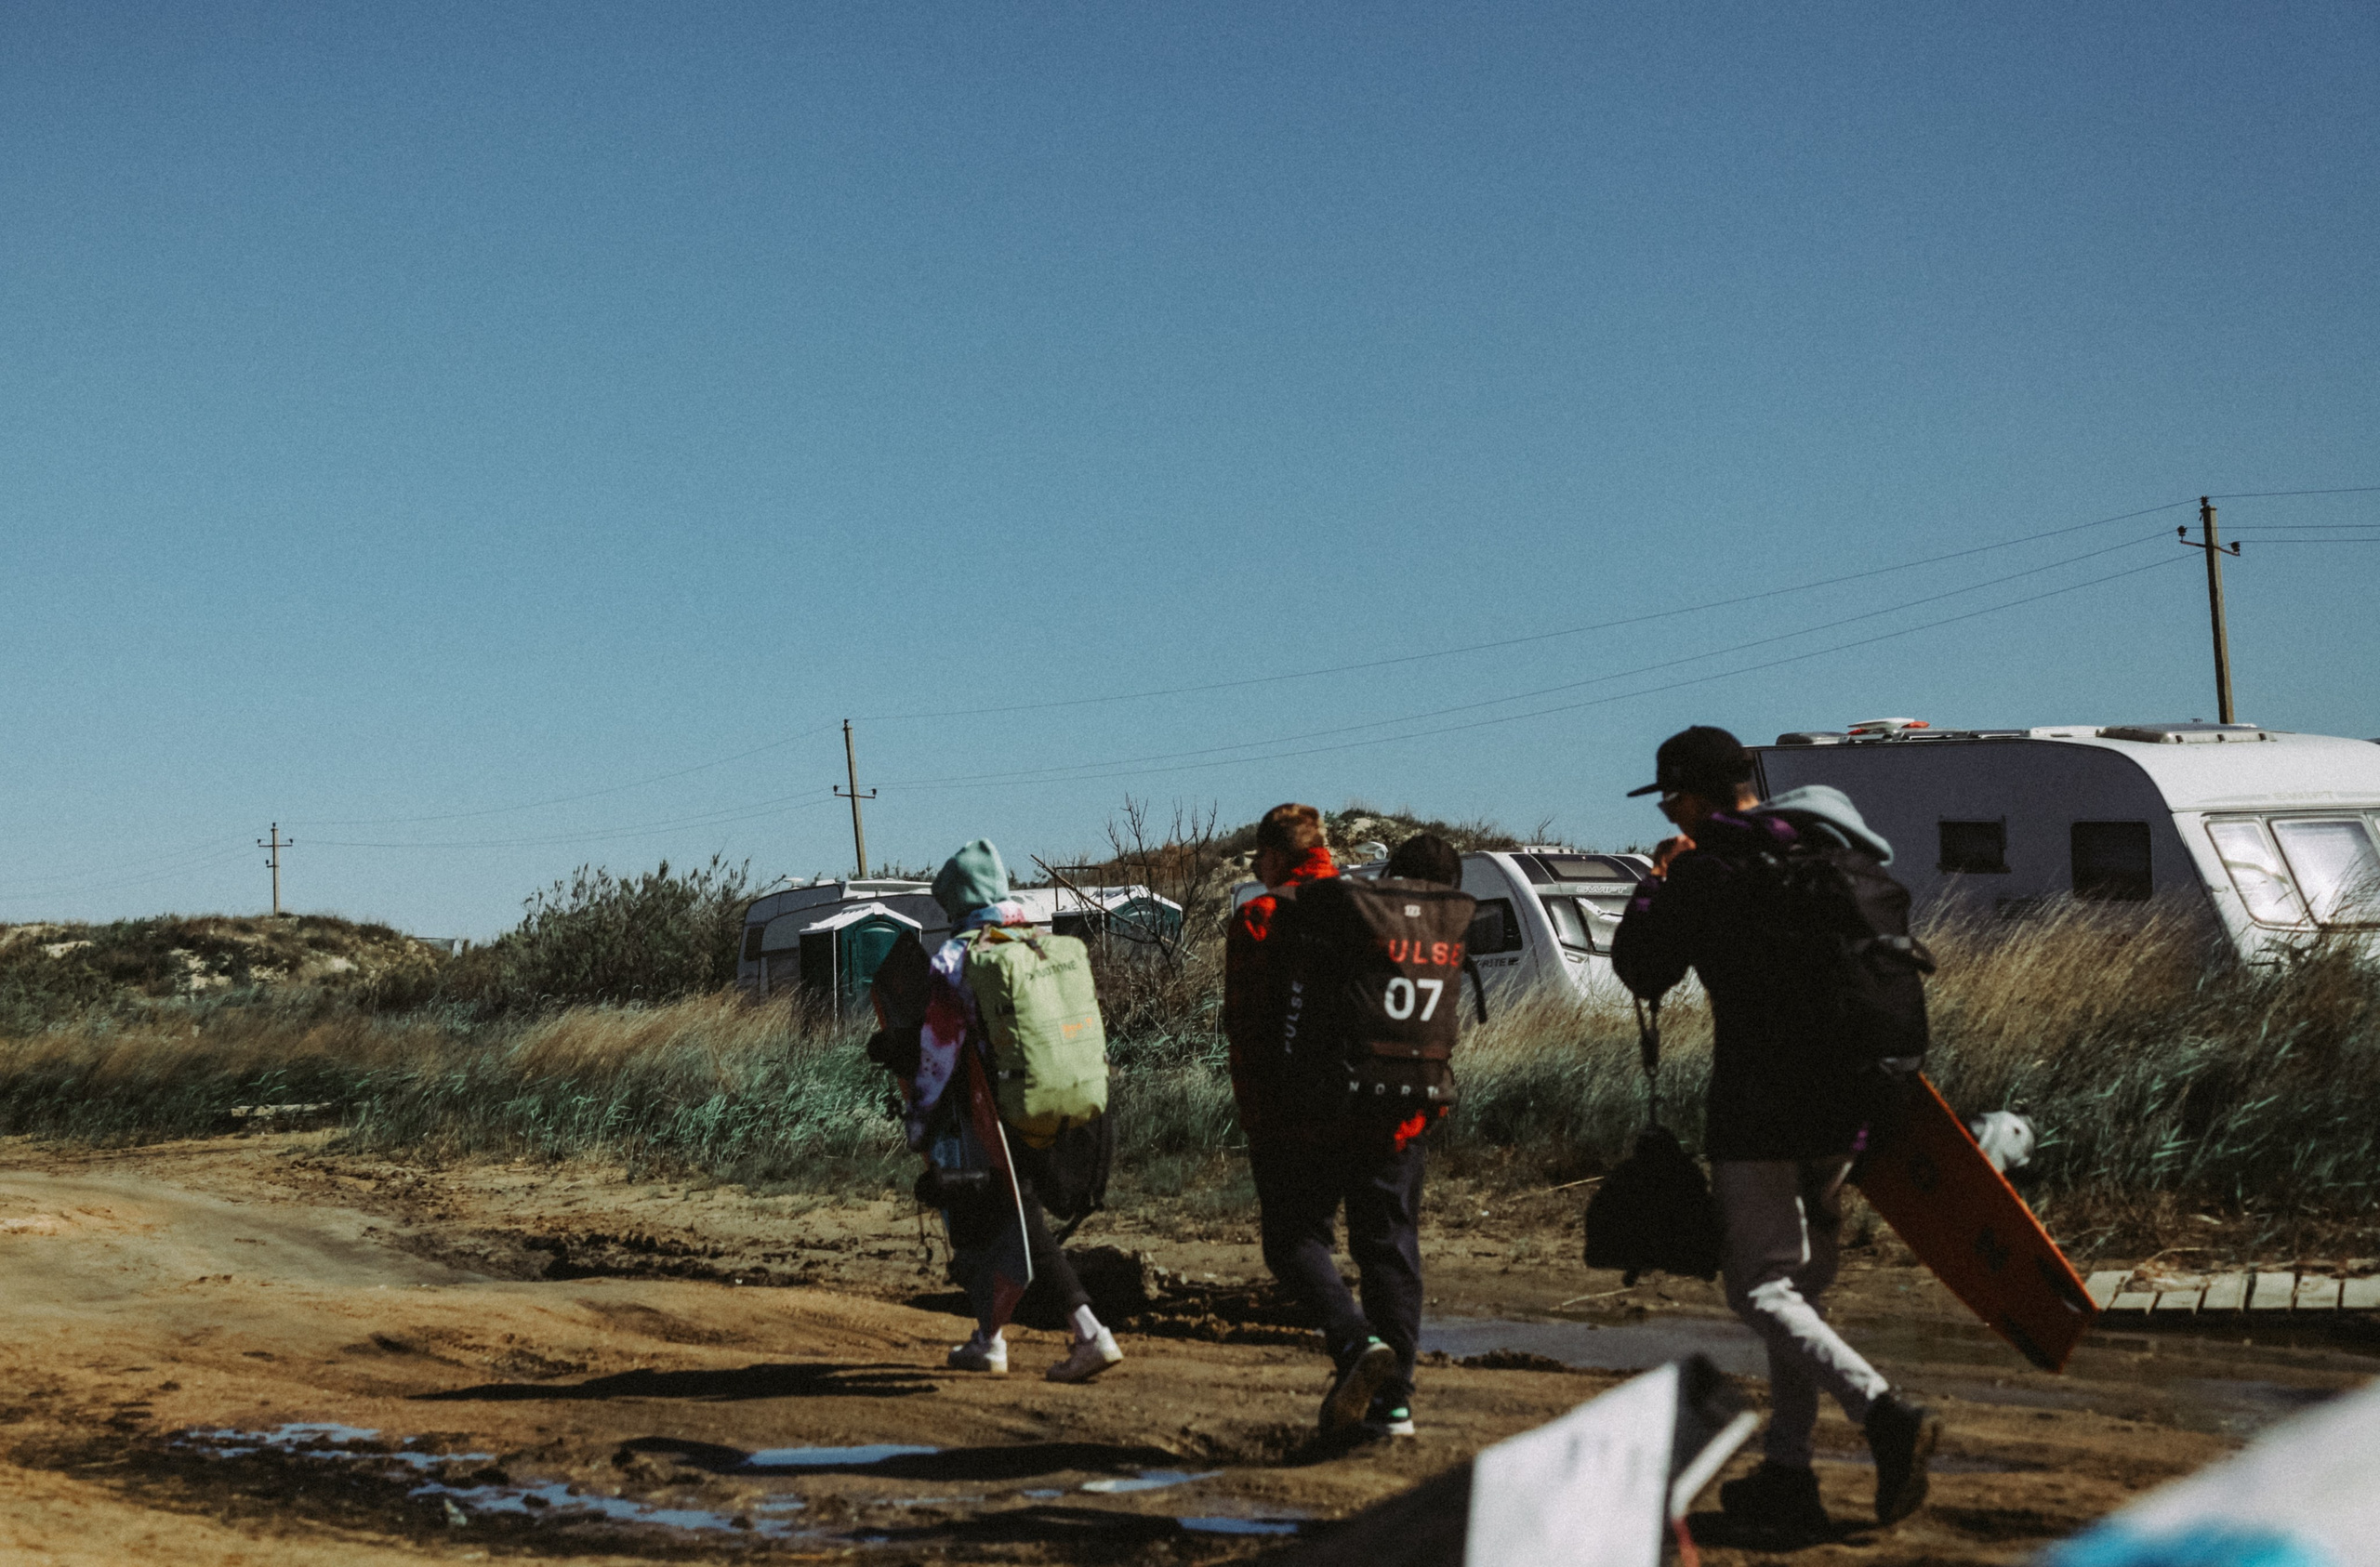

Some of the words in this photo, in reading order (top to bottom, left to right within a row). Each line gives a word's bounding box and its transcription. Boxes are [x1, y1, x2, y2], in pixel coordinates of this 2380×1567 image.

[1576, 885, 1627, 894] SWIFT
[1380, 938, 1461, 967] ULSE
[1477, 957, 1506, 968] RITE
[1384, 977, 1444, 1021] 07
[1285, 981, 1303, 1053] PULSE
[1349, 1081, 1439, 1099] NORT
